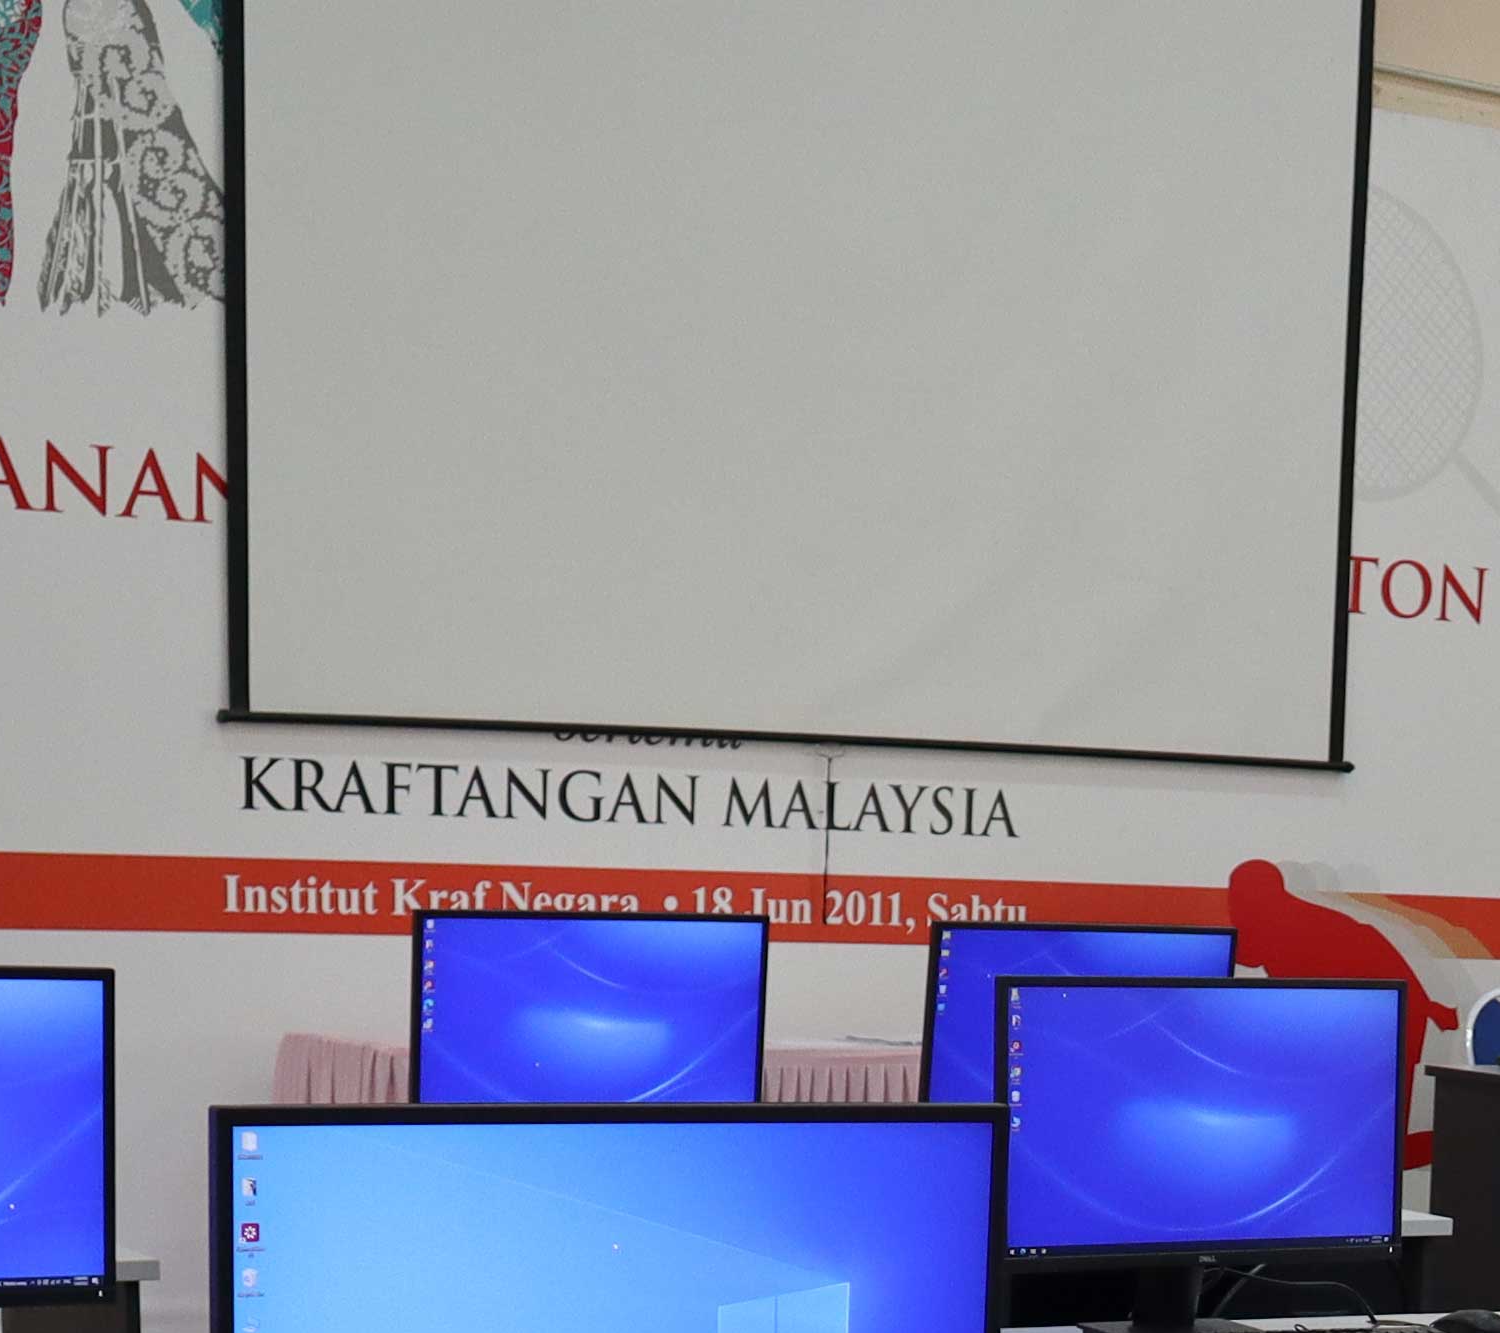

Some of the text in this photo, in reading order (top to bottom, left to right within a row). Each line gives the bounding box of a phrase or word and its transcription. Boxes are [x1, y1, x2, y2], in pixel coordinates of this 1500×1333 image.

[240, 756, 1019, 838] KRAFTANGAN MALAYSIA
[223, 874, 1027, 933] Institut Kraf Negara 18 Jun 2011, Sabtu
